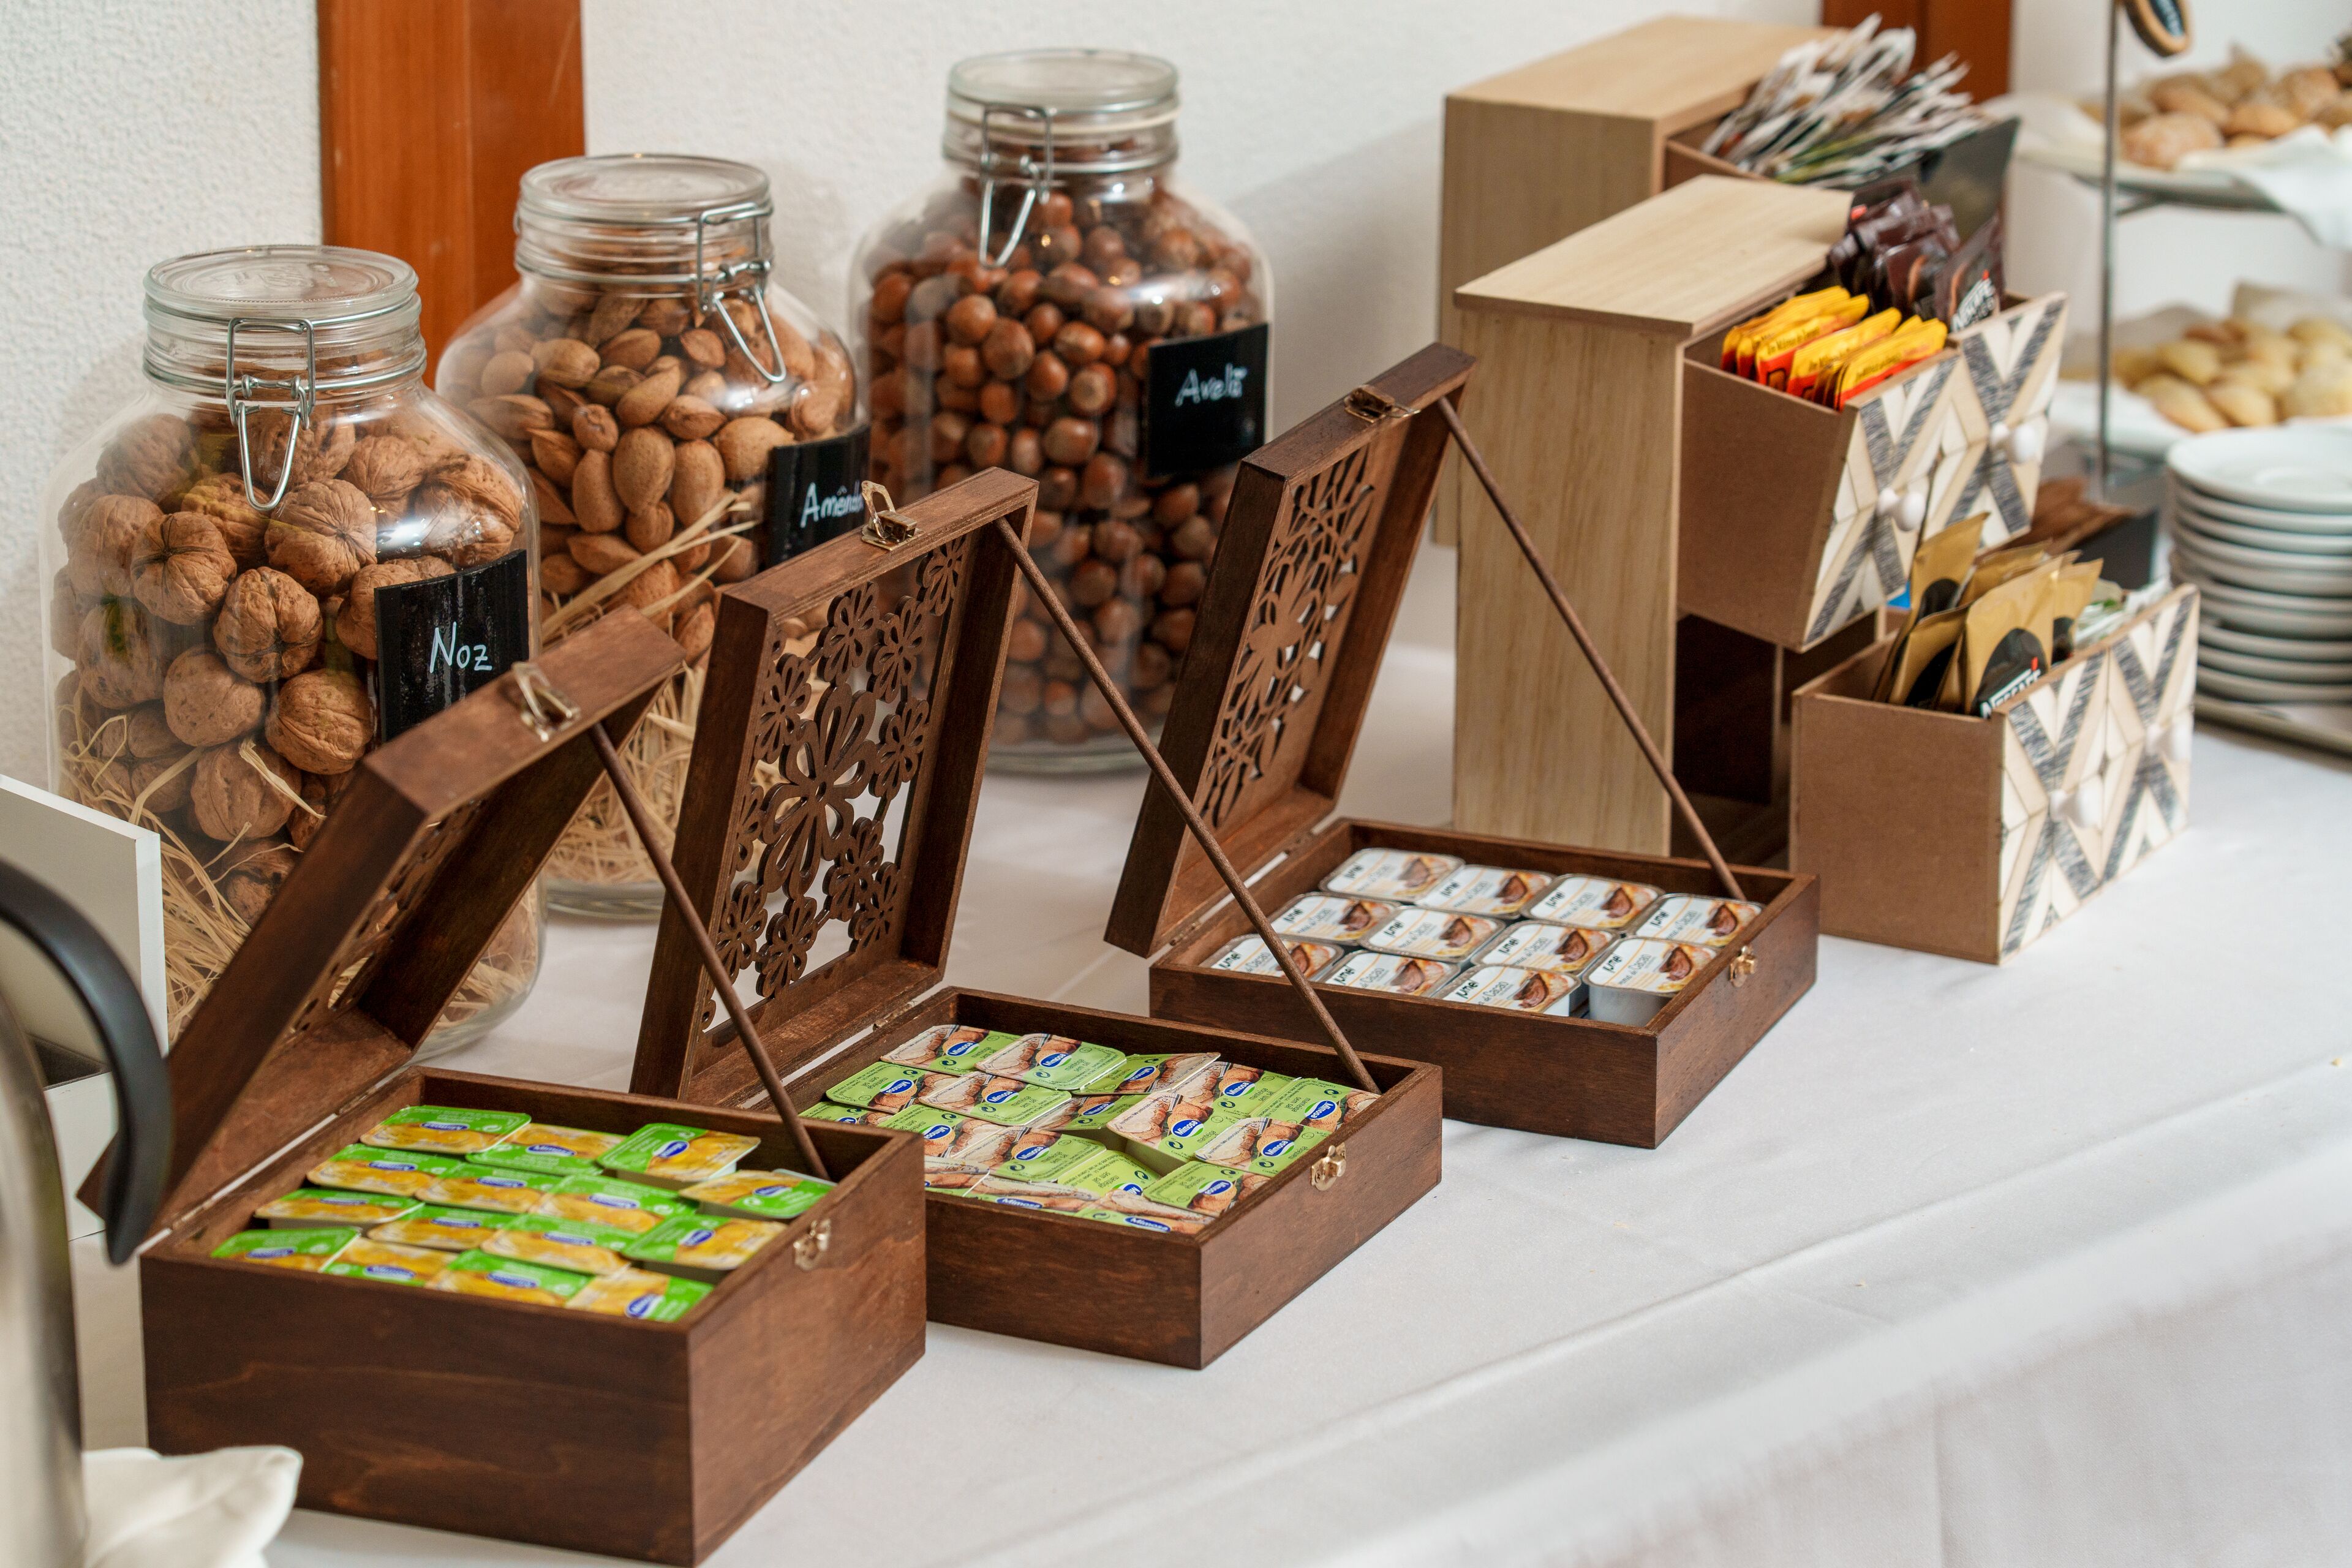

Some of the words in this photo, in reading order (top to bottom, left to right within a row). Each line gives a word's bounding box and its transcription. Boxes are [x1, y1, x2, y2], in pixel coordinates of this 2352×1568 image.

[429, 621, 492, 674] Noz
[949, 1041, 974, 1055] Mimosa
[1042, 1054, 1066, 1066] Mimosa
[886, 1081, 911, 1093] Mimosa
[1226, 1082, 1250, 1095] Mimosa
[989, 1091, 1013, 1102] Mimosa
[1311, 1102, 1334, 1118] Mimosa
[1175, 1120, 1198, 1135] Mimosa
[1018, 1146, 1044, 1159] Mimosa
[1265, 1140, 1289, 1155] Mimosa
[1002, 1198, 1041, 1208] Mimosa
